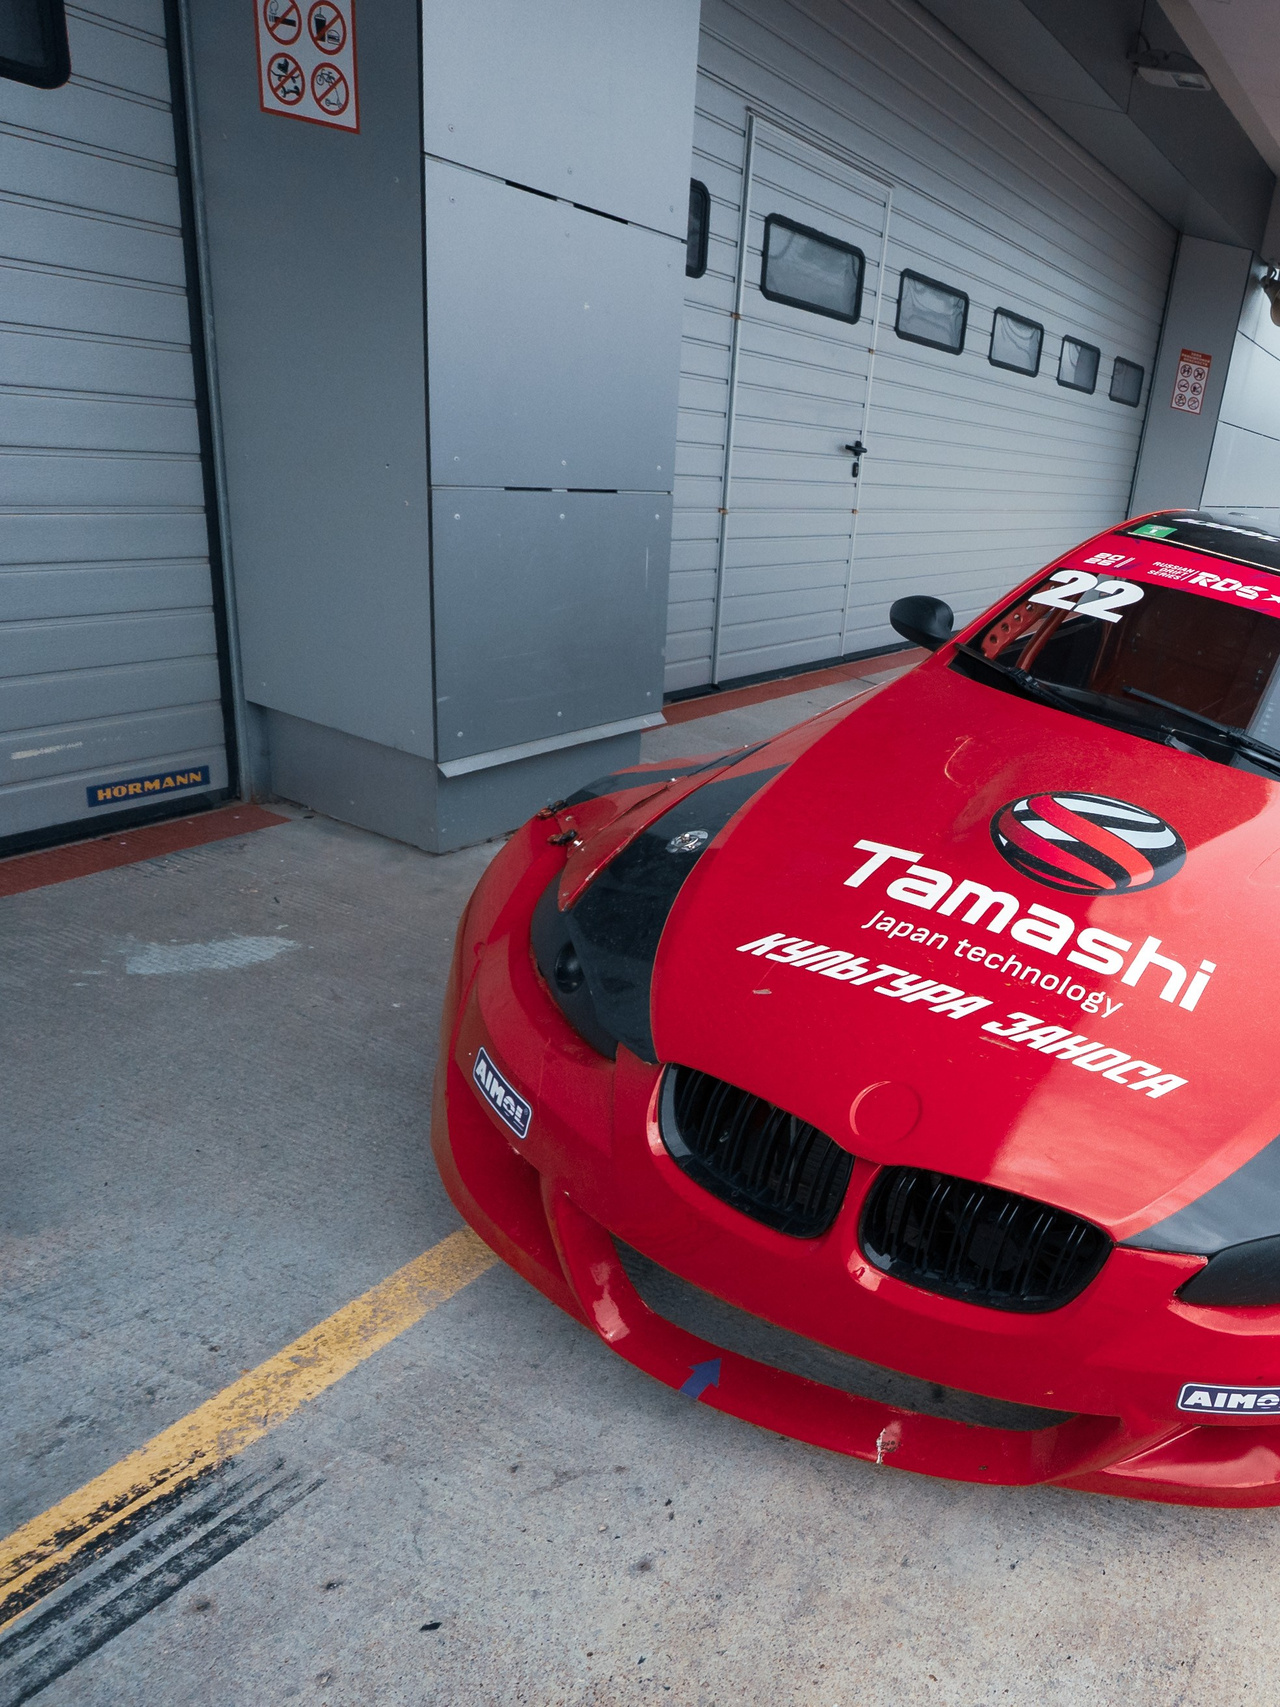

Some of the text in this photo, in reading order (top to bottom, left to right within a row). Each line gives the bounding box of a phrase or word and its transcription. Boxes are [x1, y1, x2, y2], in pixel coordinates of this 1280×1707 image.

[1147, 569, 1182, 580] SERIES
[1152, 561, 1195, 574] RUSSIAN
[1159, 568, 1189, 577] DRIFT
[1188, 571, 1269, 601] RDS
[1028, 569, 1145, 623] 22
[843, 839, 1217, 1012] Tamashi
[861, 910, 1124, 1018] Japan technology
[736, 933, 1189, 1099] КУЛЬТУРА ЗАНОСА
